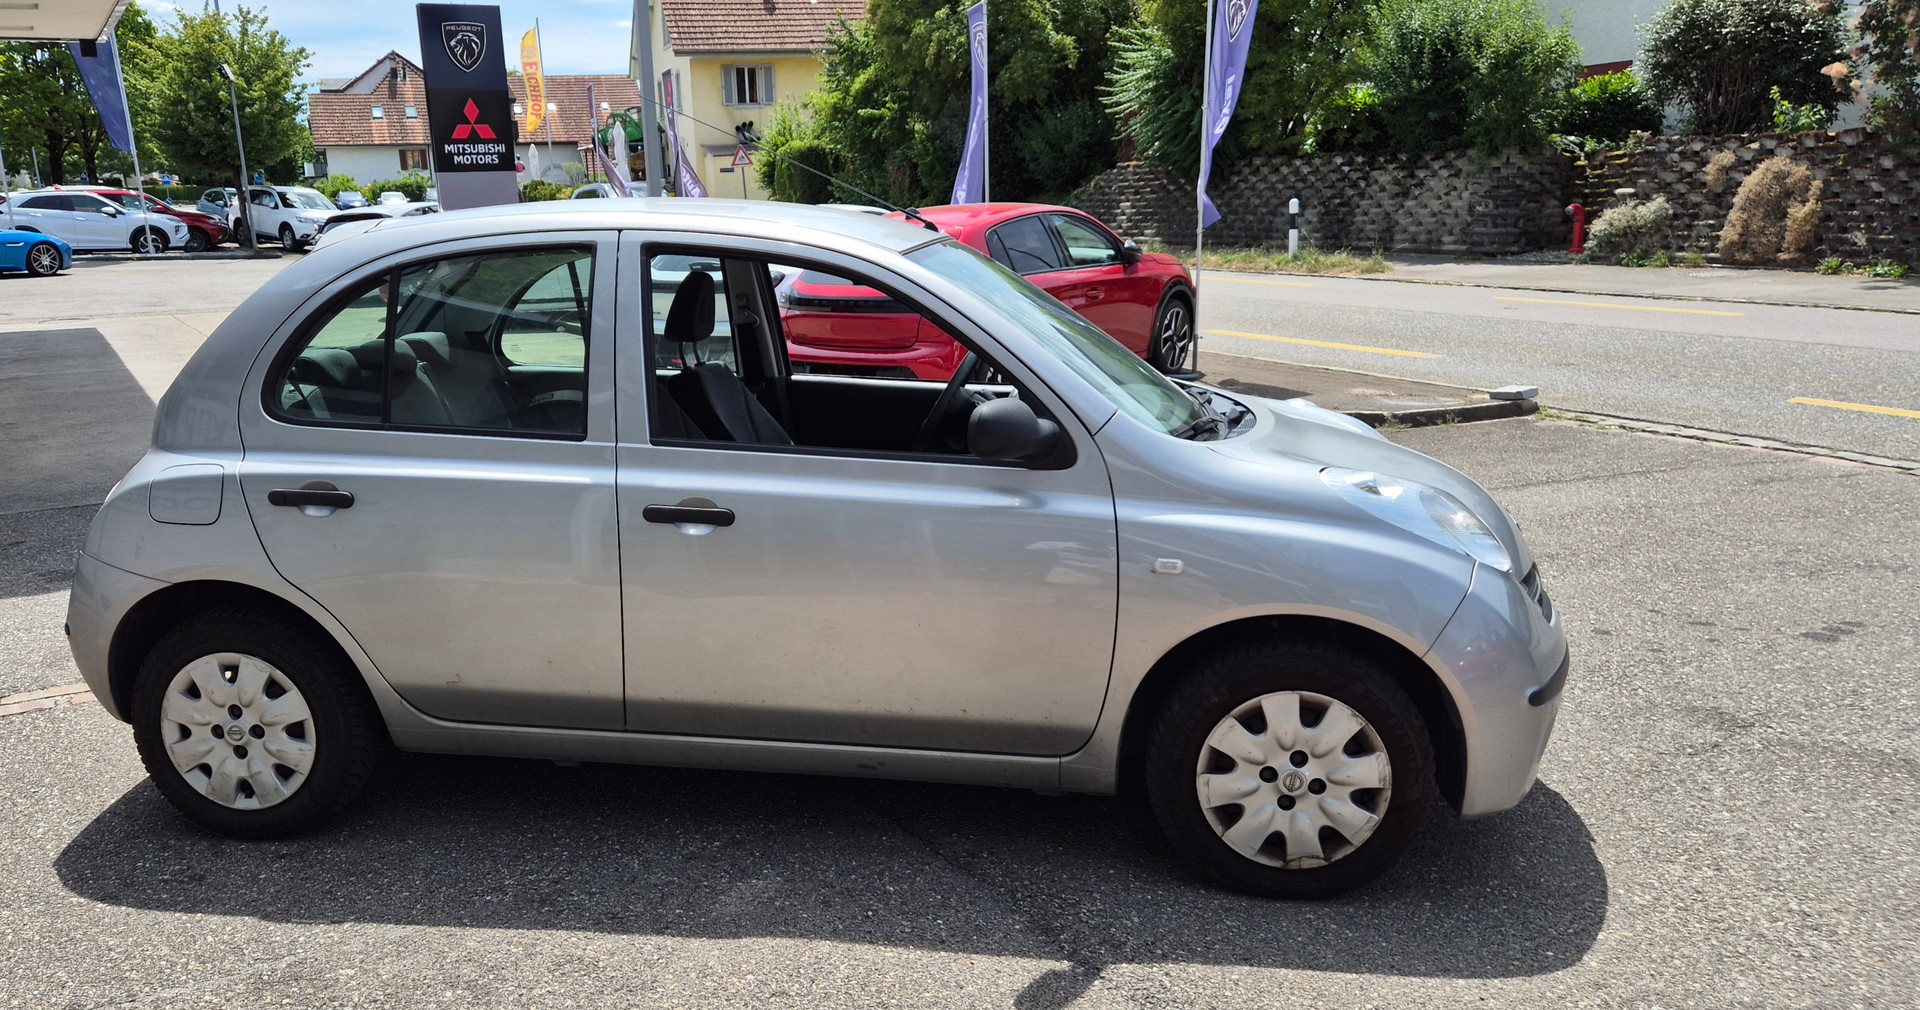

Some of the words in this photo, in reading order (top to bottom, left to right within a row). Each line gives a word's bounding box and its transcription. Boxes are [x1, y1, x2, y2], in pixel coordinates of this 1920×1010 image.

[523, 62, 542, 119] EICHHOF
[444, 143, 506, 154] MITSUBISHI
[454, 154, 499, 165] MOTORS
